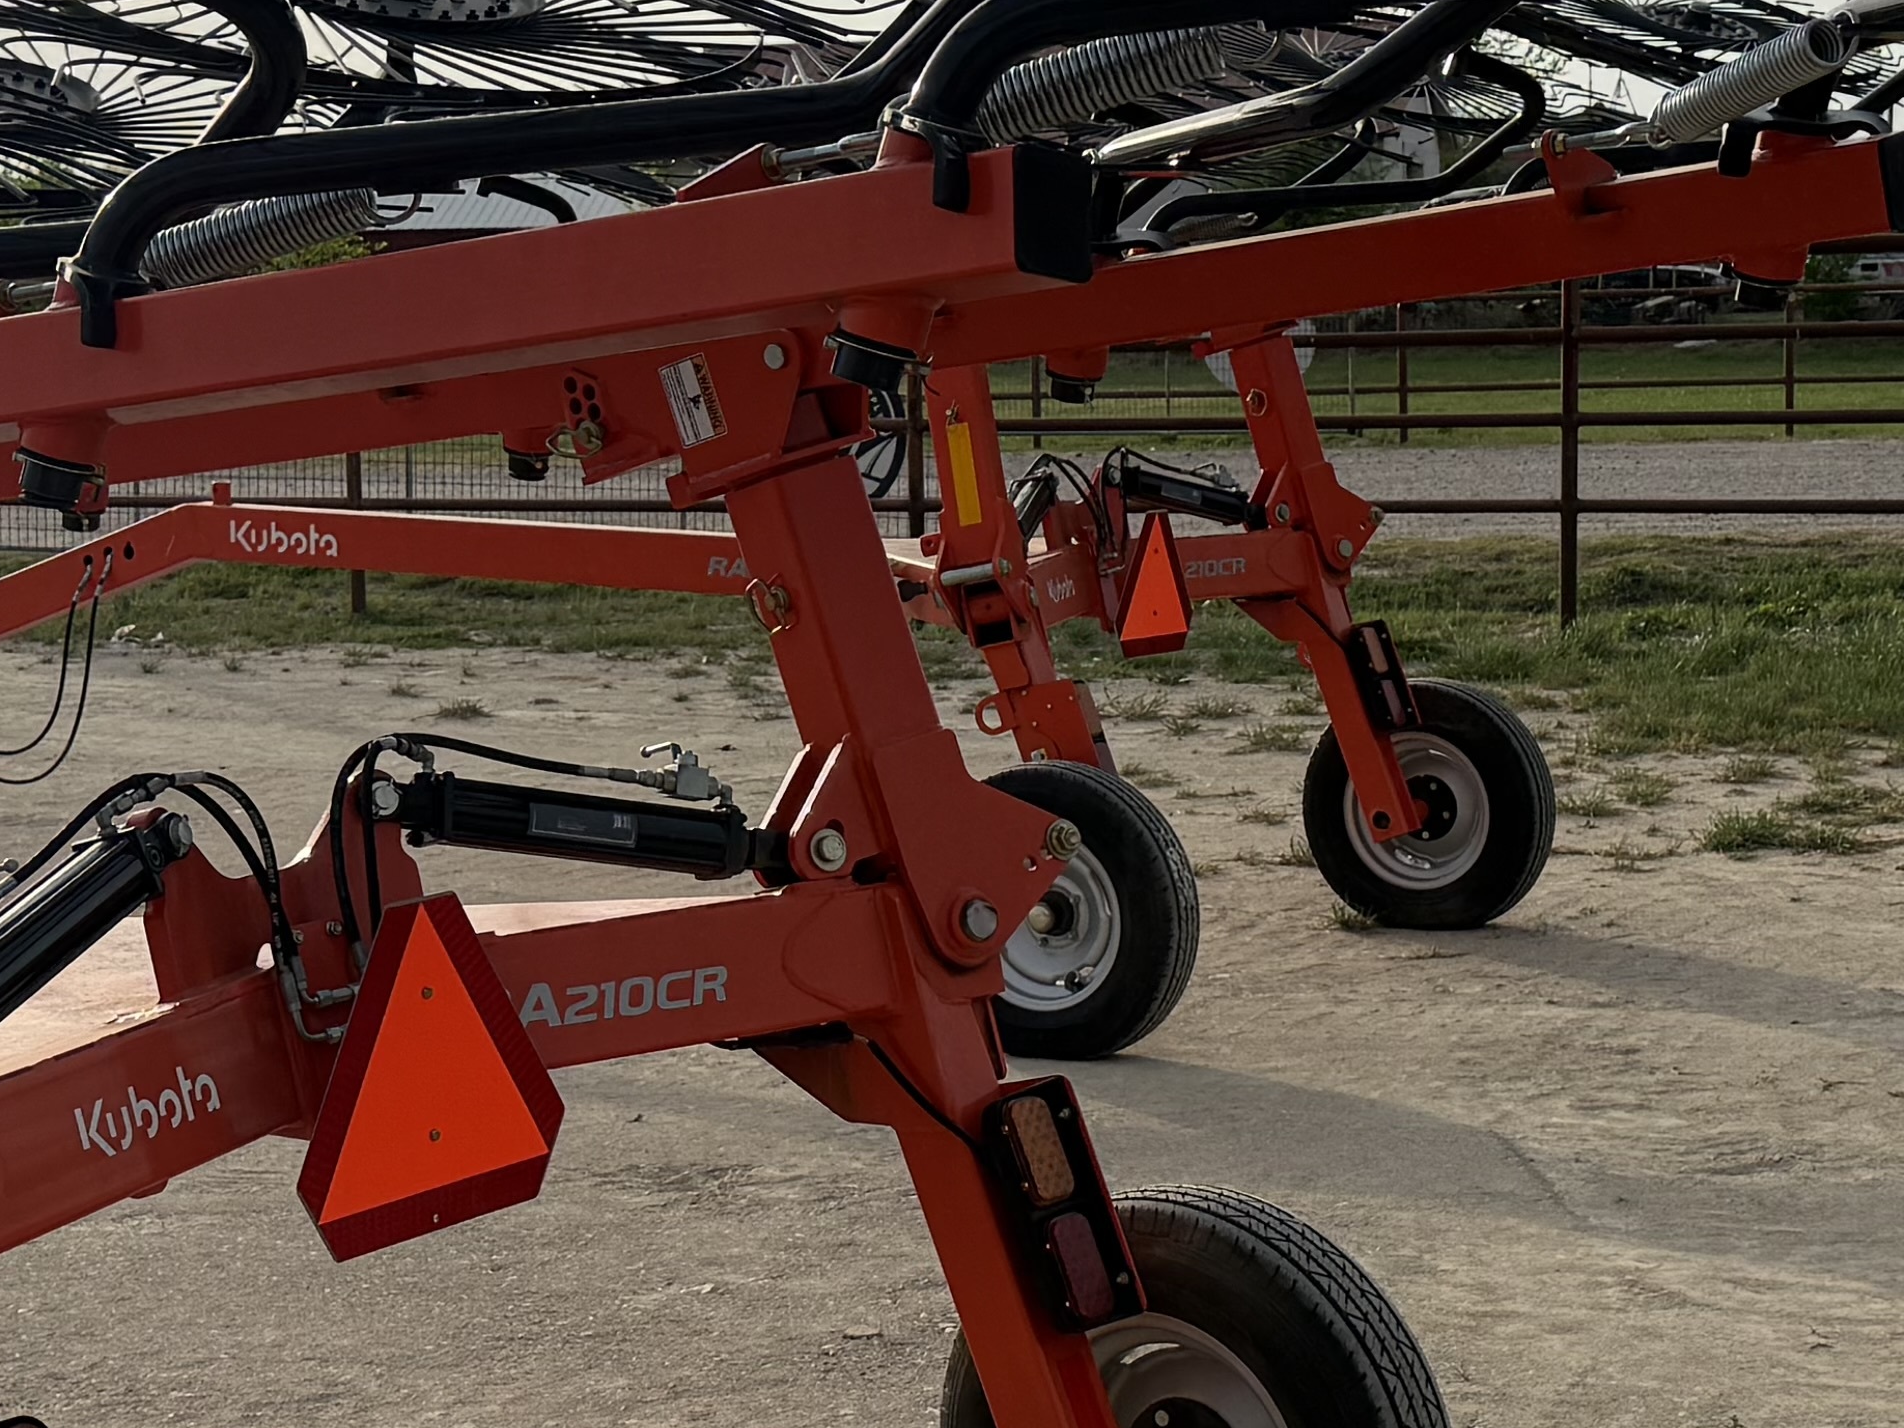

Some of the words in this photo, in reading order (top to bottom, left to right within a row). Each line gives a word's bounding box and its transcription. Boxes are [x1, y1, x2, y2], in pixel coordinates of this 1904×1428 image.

[228, 519, 338, 558] Kubota
[507, 965, 728, 1028] A210CR
[74, 1066, 221, 1157] Kubota
